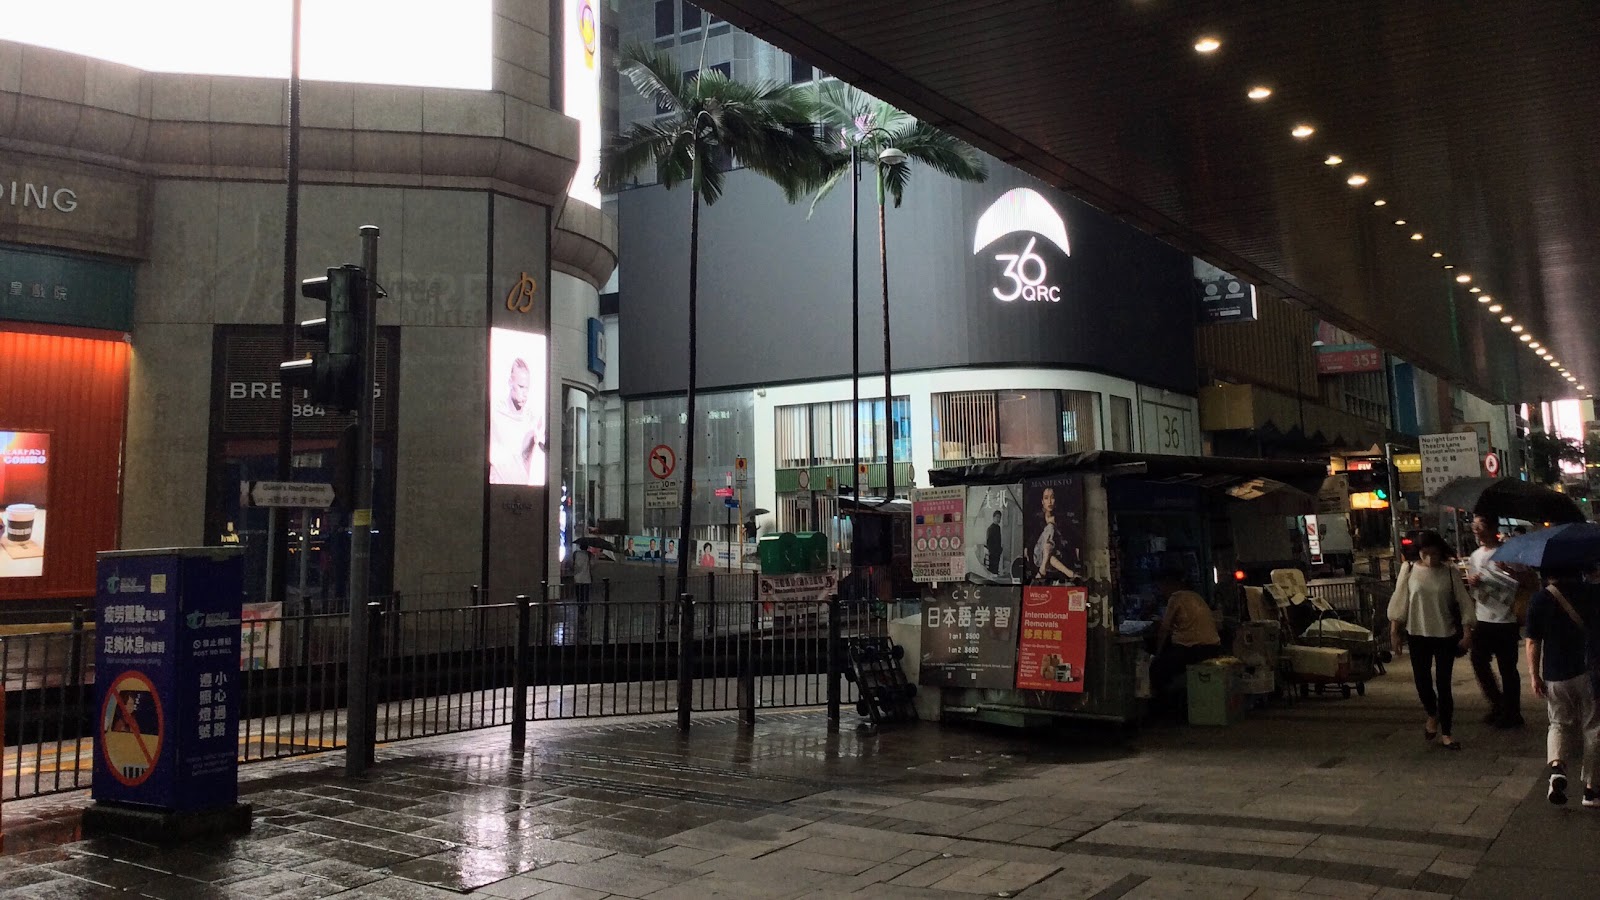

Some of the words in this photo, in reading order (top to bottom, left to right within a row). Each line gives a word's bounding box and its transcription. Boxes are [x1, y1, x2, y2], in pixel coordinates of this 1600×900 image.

[0, 181, 77, 212] ING
[992, 236, 1047, 301] 36
[1022, 285, 1061, 302] QRC
[1163, 415, 1180, 449] 36
[927, 605, 1011, 628] 日本語学習
[1024, 611, 1068, 620] International
[1024, 620, 1059, 628] Removals
